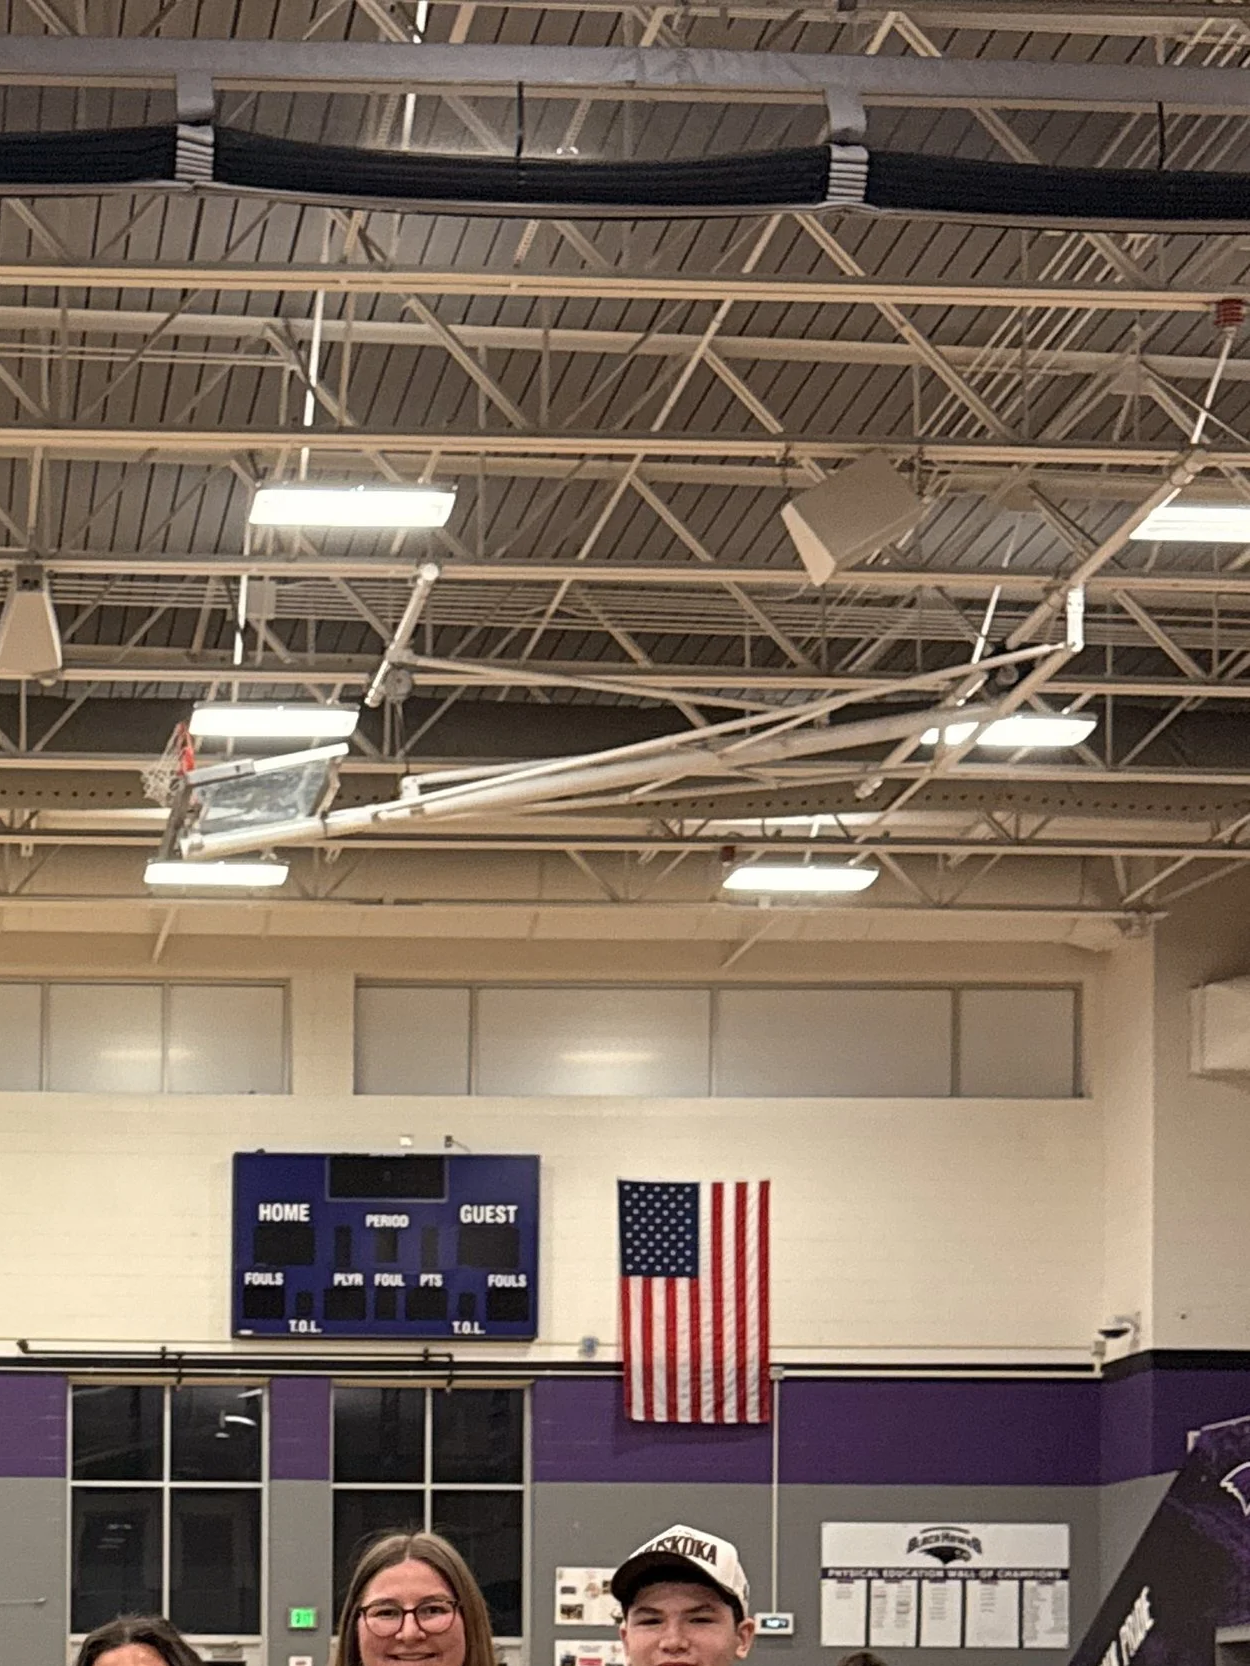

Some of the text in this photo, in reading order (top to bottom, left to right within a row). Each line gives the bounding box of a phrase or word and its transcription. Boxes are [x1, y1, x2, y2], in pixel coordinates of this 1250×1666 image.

[258, 1203, 310, 1222] HOME
[460, 1205, 518, 1223] GUEST
[365, 1215, 409, 1228] PERIOD
[244, 1273, 284, 1286] FOULS
[333, 1273, 443, 1287] PLYR FOUL PTS
[487, 1274, 527, 1287] FOULS
[882, 1569, 945, 1578] EDUCATION
[946, 1569, 975, 1578] WALL
[978, 1570, 994, 1579] OF
